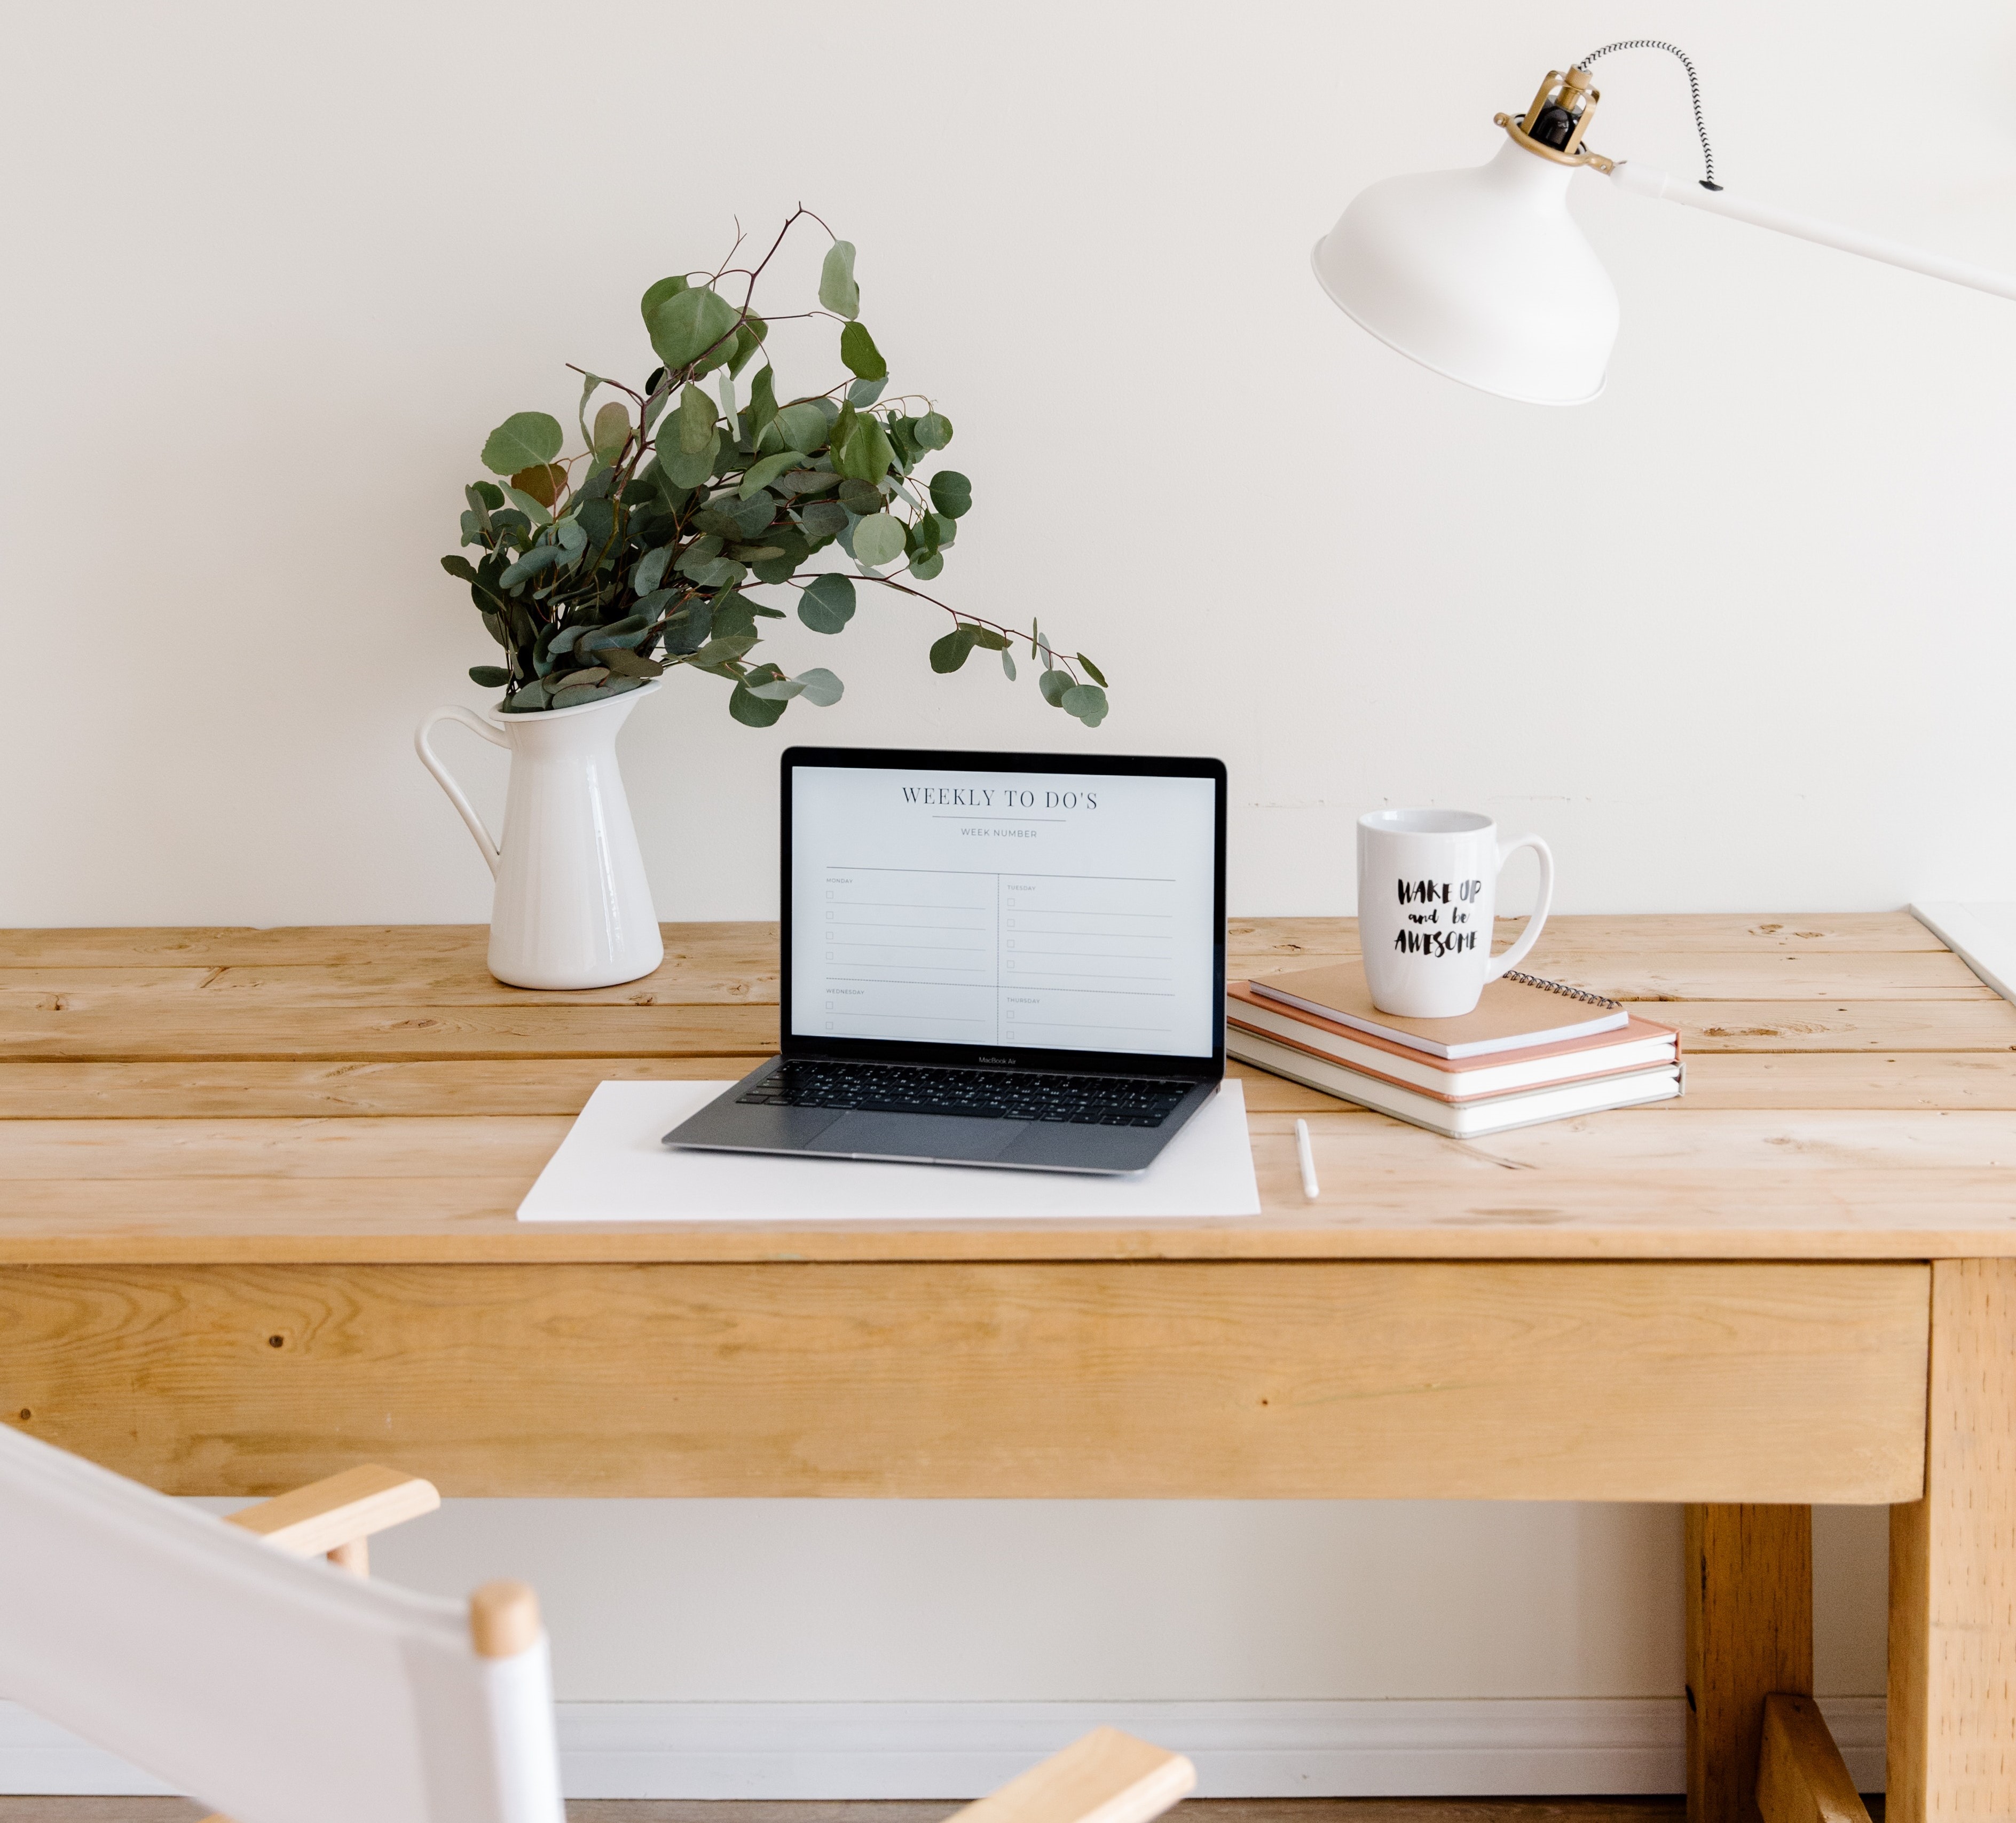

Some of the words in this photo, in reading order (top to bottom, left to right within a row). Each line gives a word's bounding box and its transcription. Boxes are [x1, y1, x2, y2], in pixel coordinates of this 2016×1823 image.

[902, 787, 995, 807] WEEKLY
[1004, 790, 1035, 808] TO
[1045, 792, 1098, 810] DO'S
[960, 828, 990, 836] WEEK
[993, 829, 1037, 838] NUMBER
[1397, 878, 1453, 905] WAKE
[1460, 880, 1482, 904] UP
[1408, 909, 1439, 925] and
[1452, 906, 1470, 924] be
[1393, 929, 1478, 958] AWESOME
